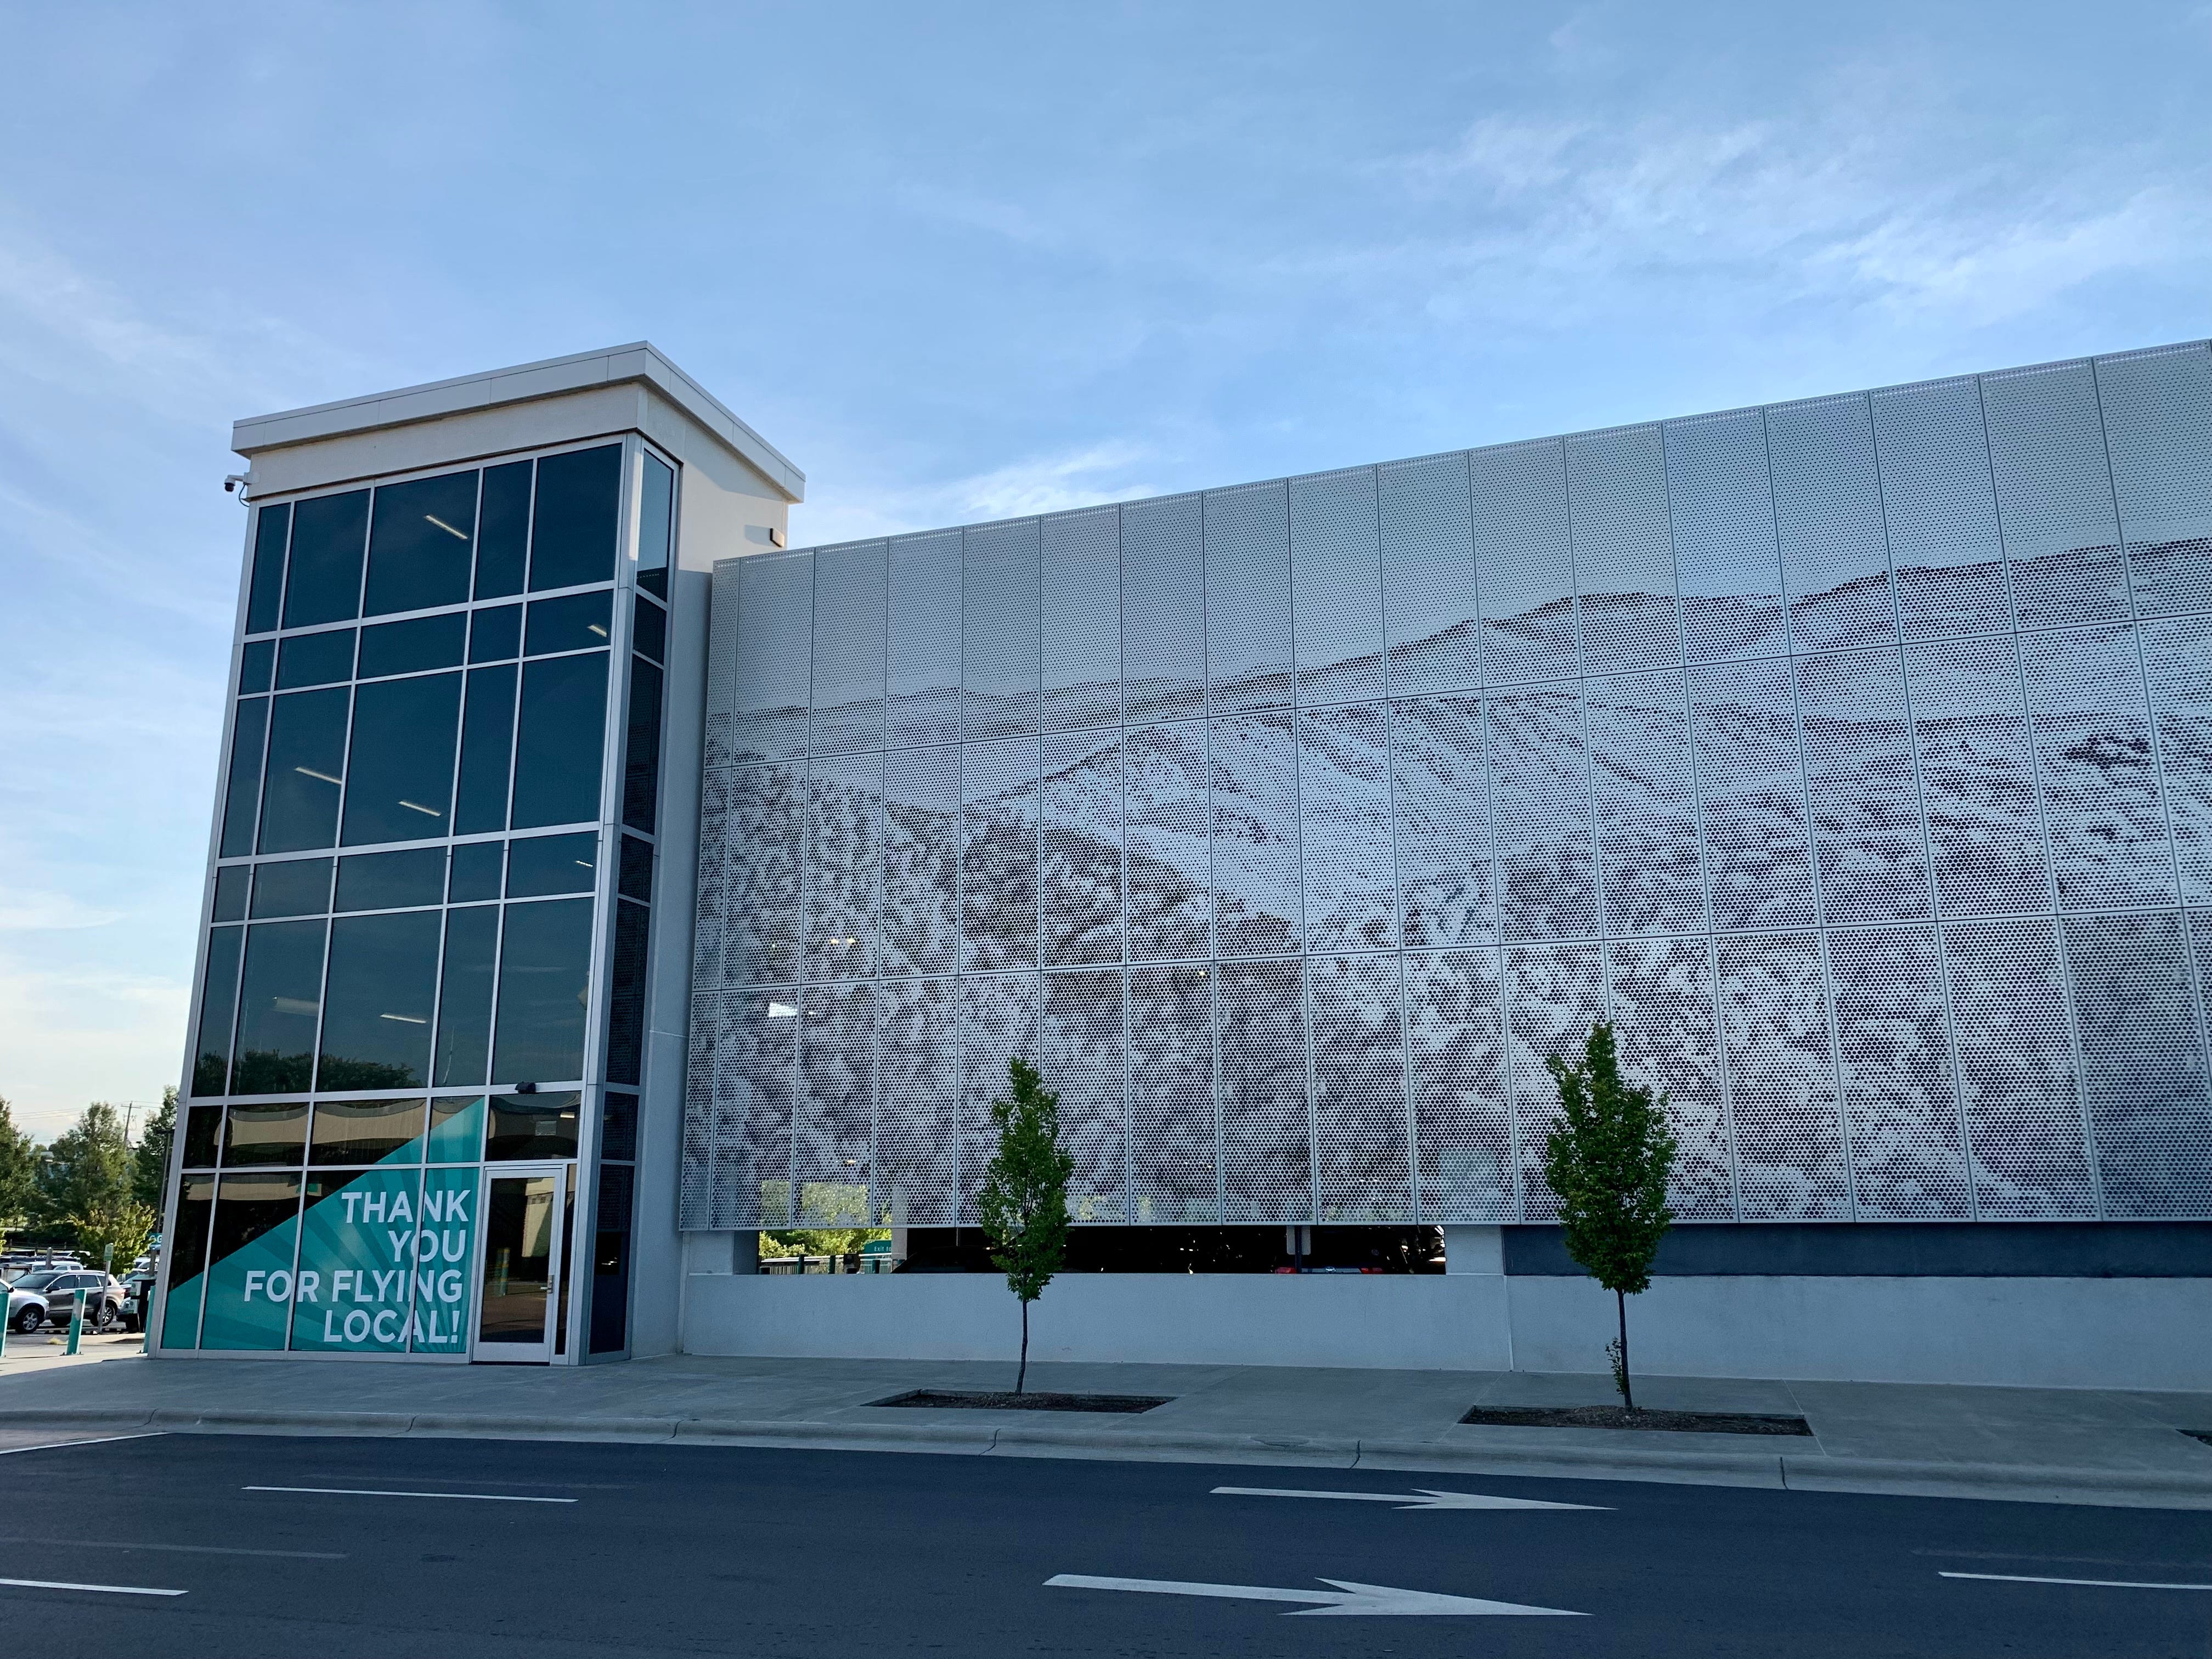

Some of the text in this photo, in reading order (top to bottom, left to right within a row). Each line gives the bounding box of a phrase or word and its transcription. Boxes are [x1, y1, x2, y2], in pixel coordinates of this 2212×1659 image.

[341, 1190, 470, 1223] THANK
[388, 1229, 466, 1262] YOU
[244, 1269, 462, 1303] FOR FLYING
[324, 1310, 460, 1344] LOCAL!
